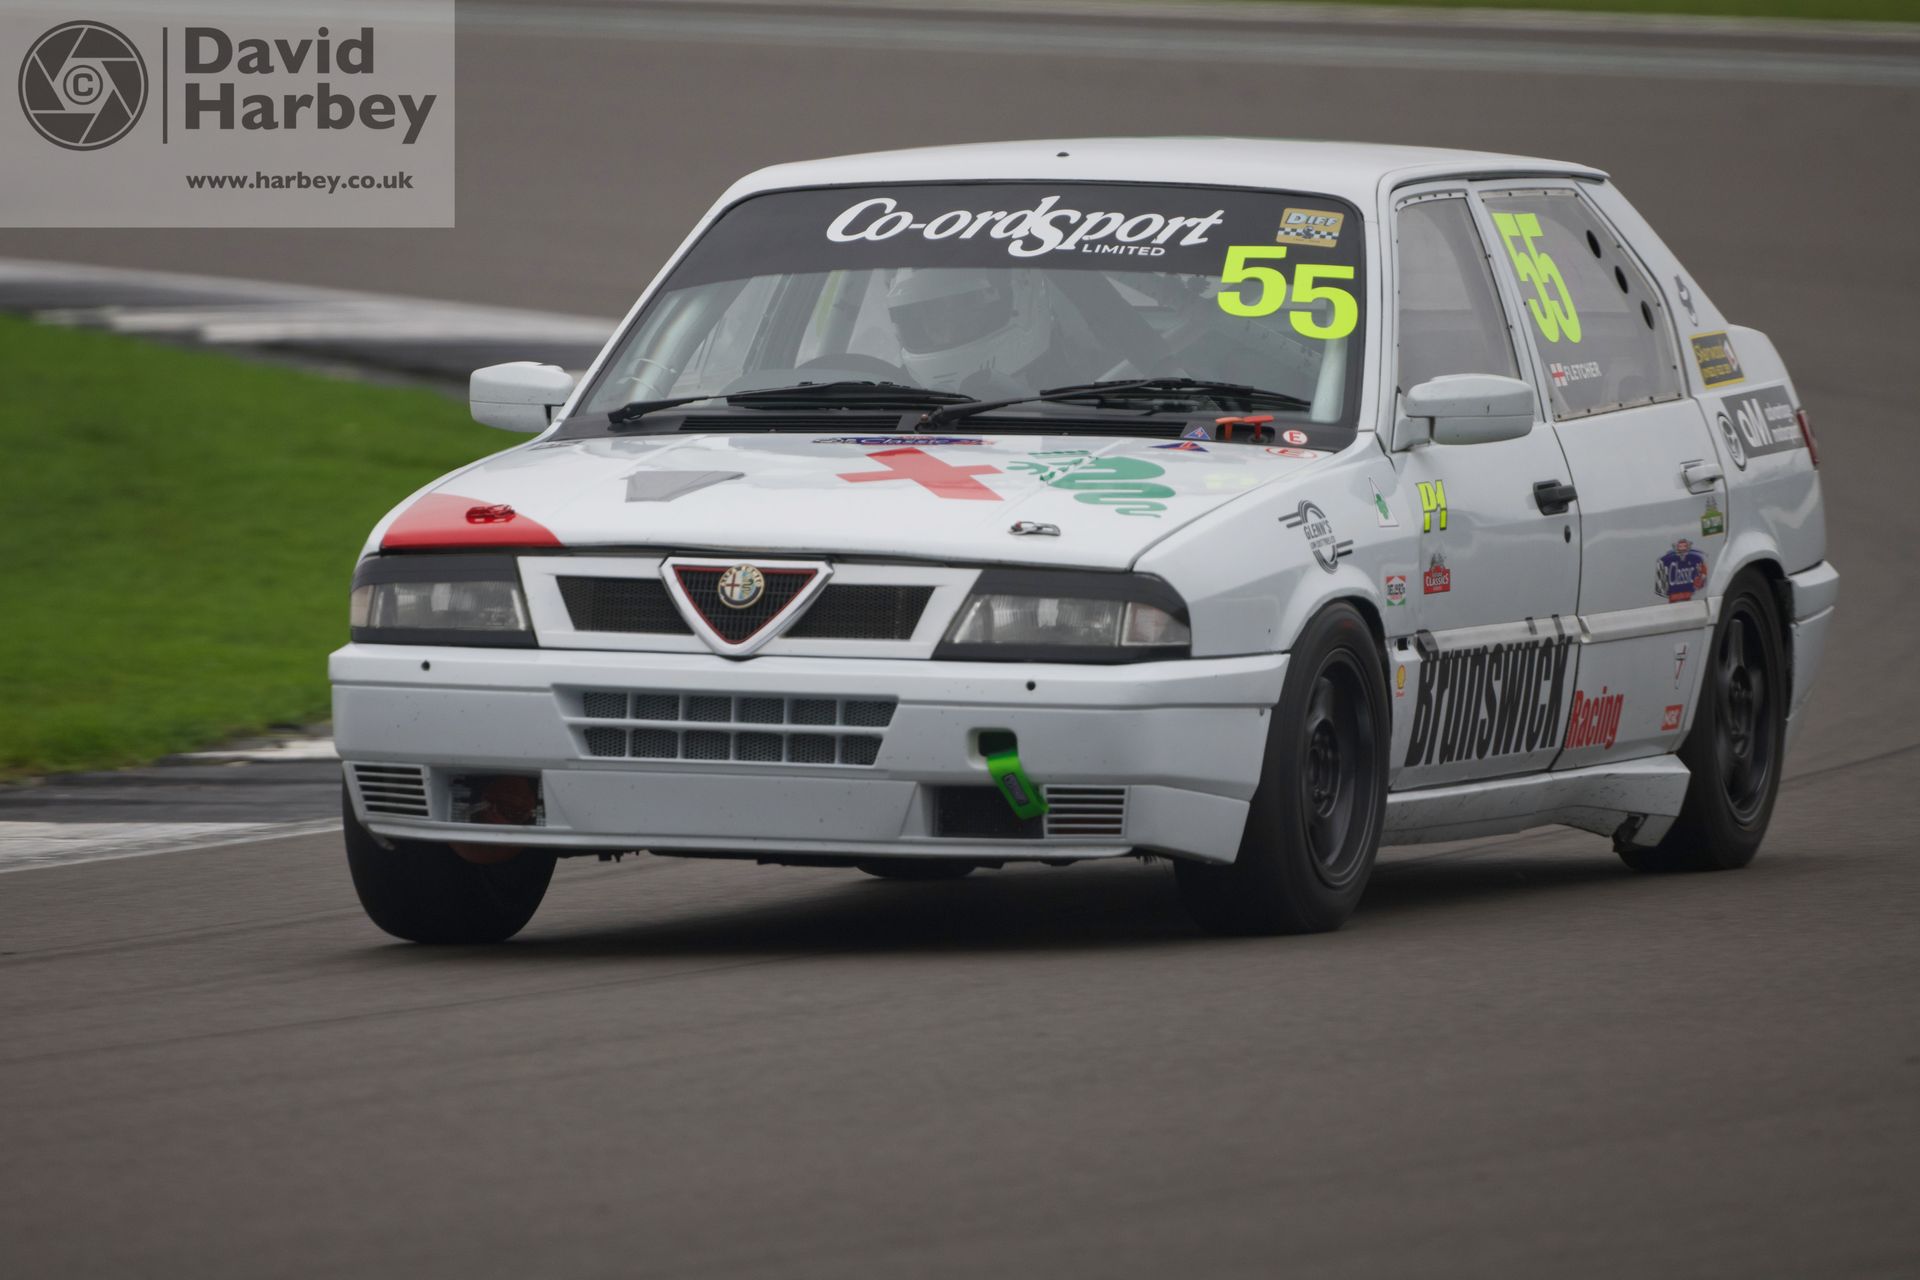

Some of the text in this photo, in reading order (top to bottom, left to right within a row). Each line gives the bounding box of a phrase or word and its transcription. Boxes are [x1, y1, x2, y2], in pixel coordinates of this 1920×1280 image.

[1082, 243, 1166, 257] LIMITED
[1491, 212, 1582, 343] 55
[1217, 245, 1359, 340] 55
[1303, 519, 1334, 541] GLENN'S
[1415, 479, 1448, 533] P1
[1564, 685, 1625, 751] Racing
